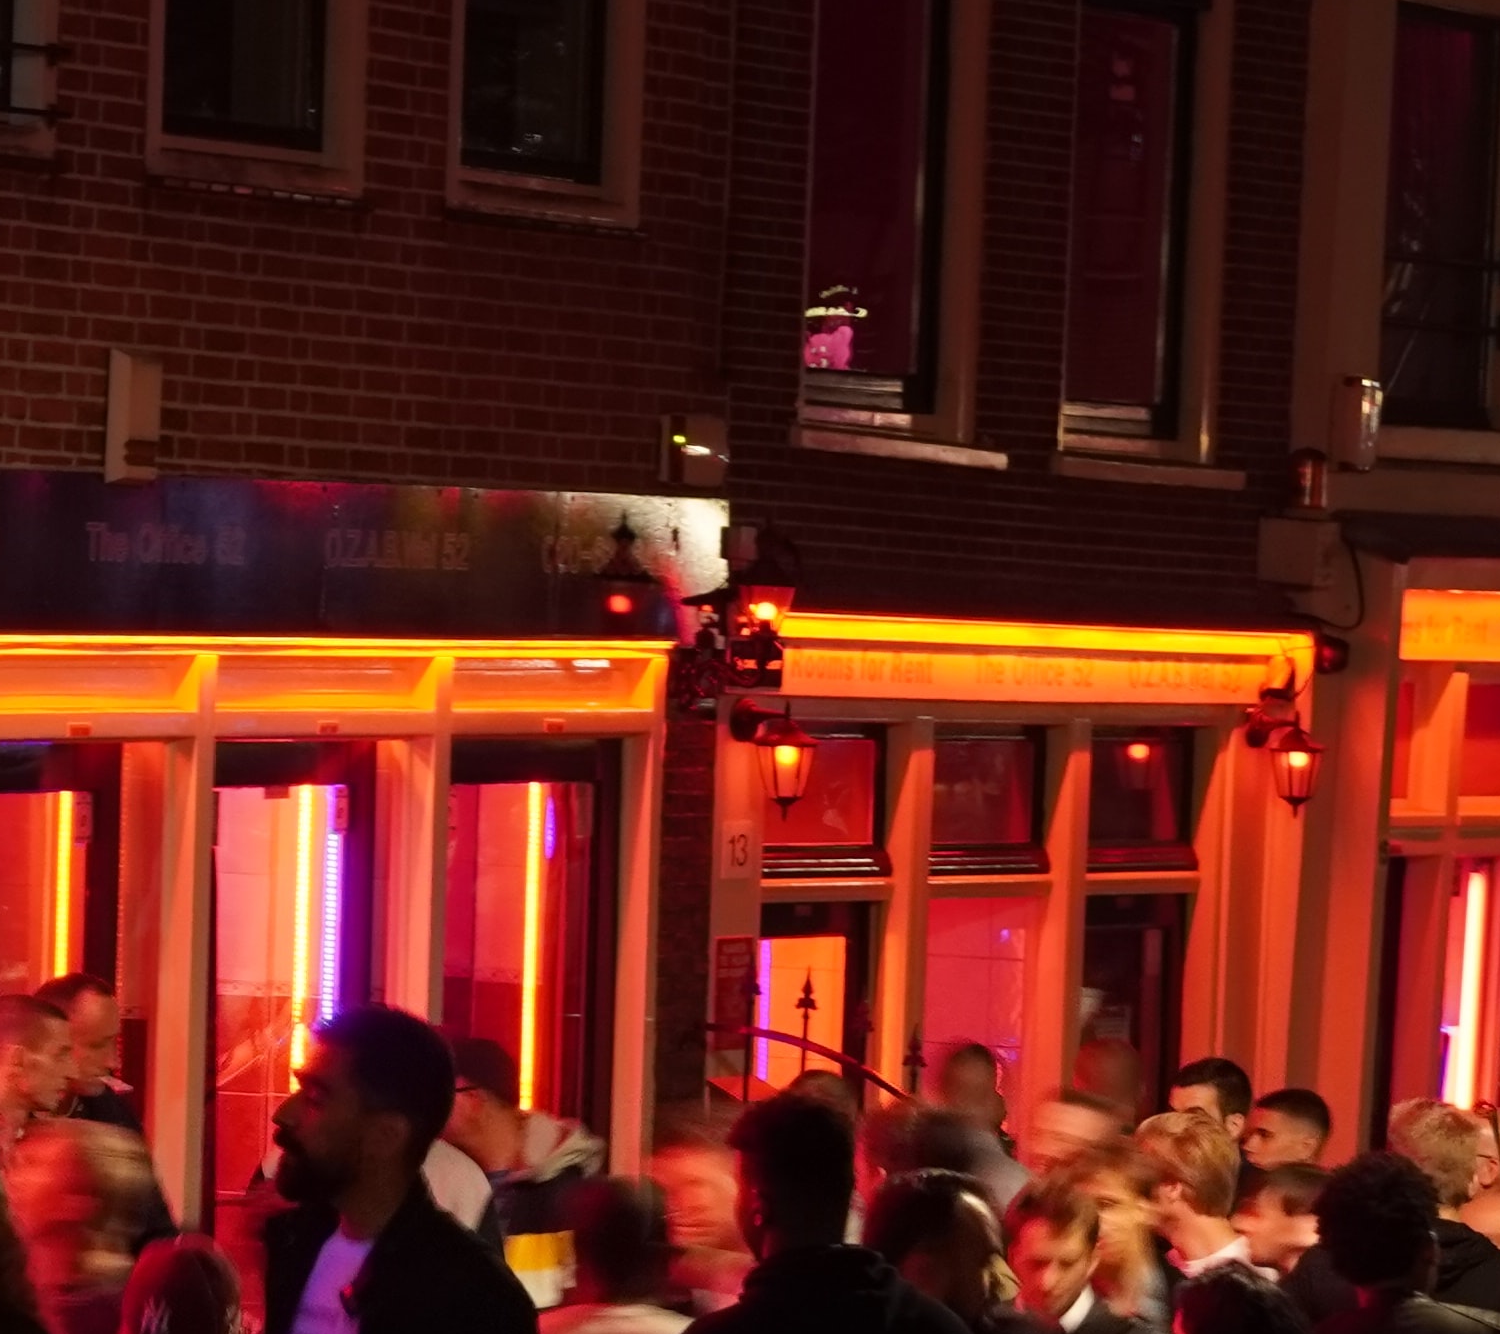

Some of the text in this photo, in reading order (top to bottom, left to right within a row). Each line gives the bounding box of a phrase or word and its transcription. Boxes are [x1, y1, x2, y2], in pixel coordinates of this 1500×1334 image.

[85, 521, 130, 562] The
[442, 532, 470, 571] 52
[728, 833, 748, 867] 13
